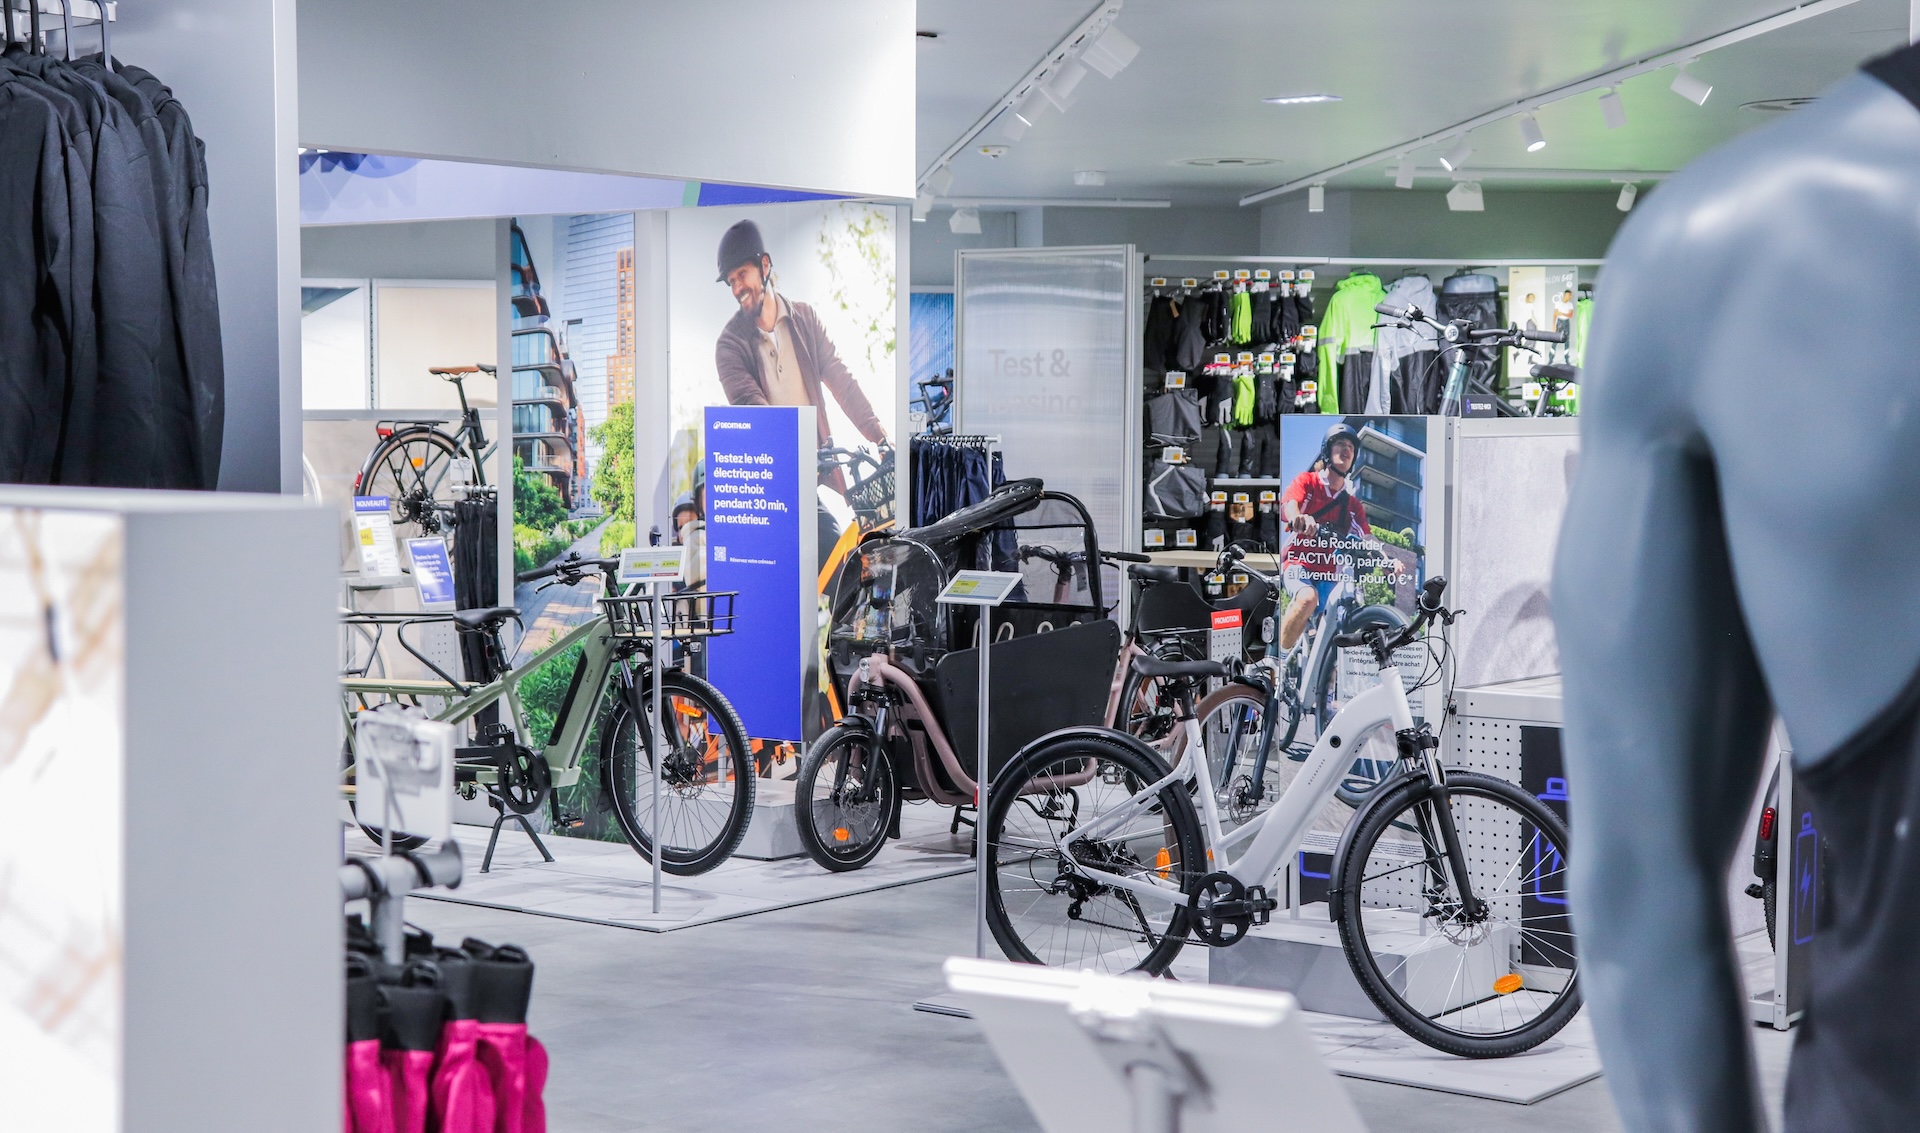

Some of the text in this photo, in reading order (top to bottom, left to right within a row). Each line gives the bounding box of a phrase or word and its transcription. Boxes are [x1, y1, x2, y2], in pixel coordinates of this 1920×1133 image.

[987, 347, 1072, 378] Test &
[720, 421, 752, 429] DECATHLON
[713, 451, 774, 464] Testez le vélo
[713, 466, 773, 481] électrique de
[713, 483, 765, 494] votre choix
[356, 499, 387, 508] NOUVEAUTÉ
[713, 497, 788, 513] pendant 30 min,
[714, 513, 770, 525] en extérieur.
[1288, 536, 1385, 550] Avec le Rockrider
[1287, 551, 1395, 569] E-ACTV100, partez
[1359, 573, 1386, 585] pour
[1387, 573, 1396, 585] 0
[1214, 615, 1239, 624] PROMOTION
